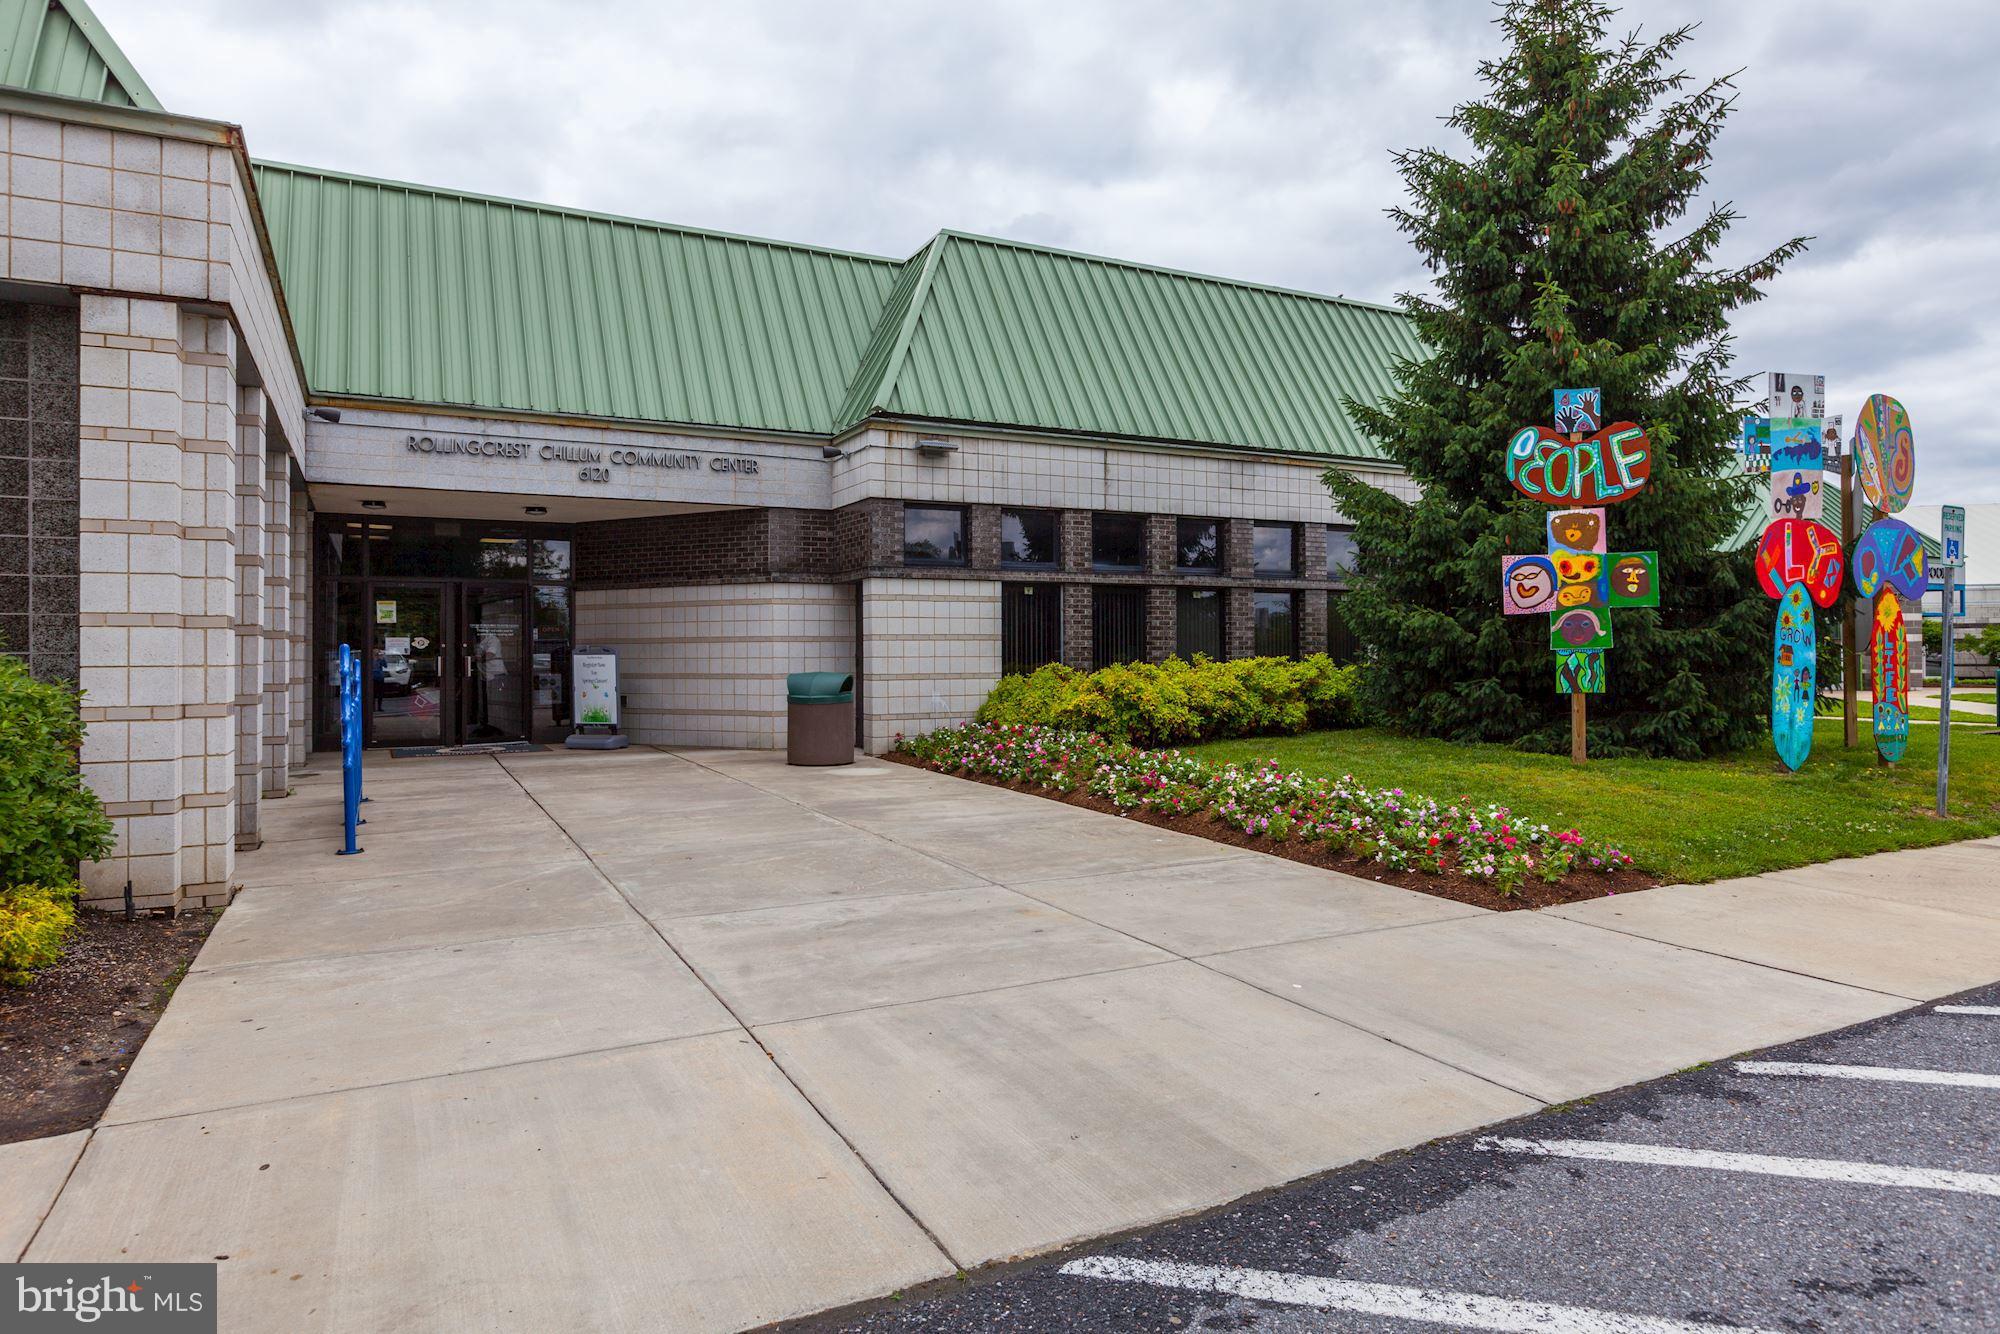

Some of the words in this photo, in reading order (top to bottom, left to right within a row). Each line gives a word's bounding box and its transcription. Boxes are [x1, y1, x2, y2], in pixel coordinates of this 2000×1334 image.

[407, 436, 530, 458] ROLLINGCREST
[539, 445, 600, 462] CHILLUM
[610, 450, 702, 470] COMMUNITY
[709, 457, 759, 474] CENTER
[1506, 426, 1646, 500] PEOPLE
[579, 467, 610, 482] 6120
[1780, 627, 1812, 647] GROW
[1884, 632, 1897, 703] LIFE
